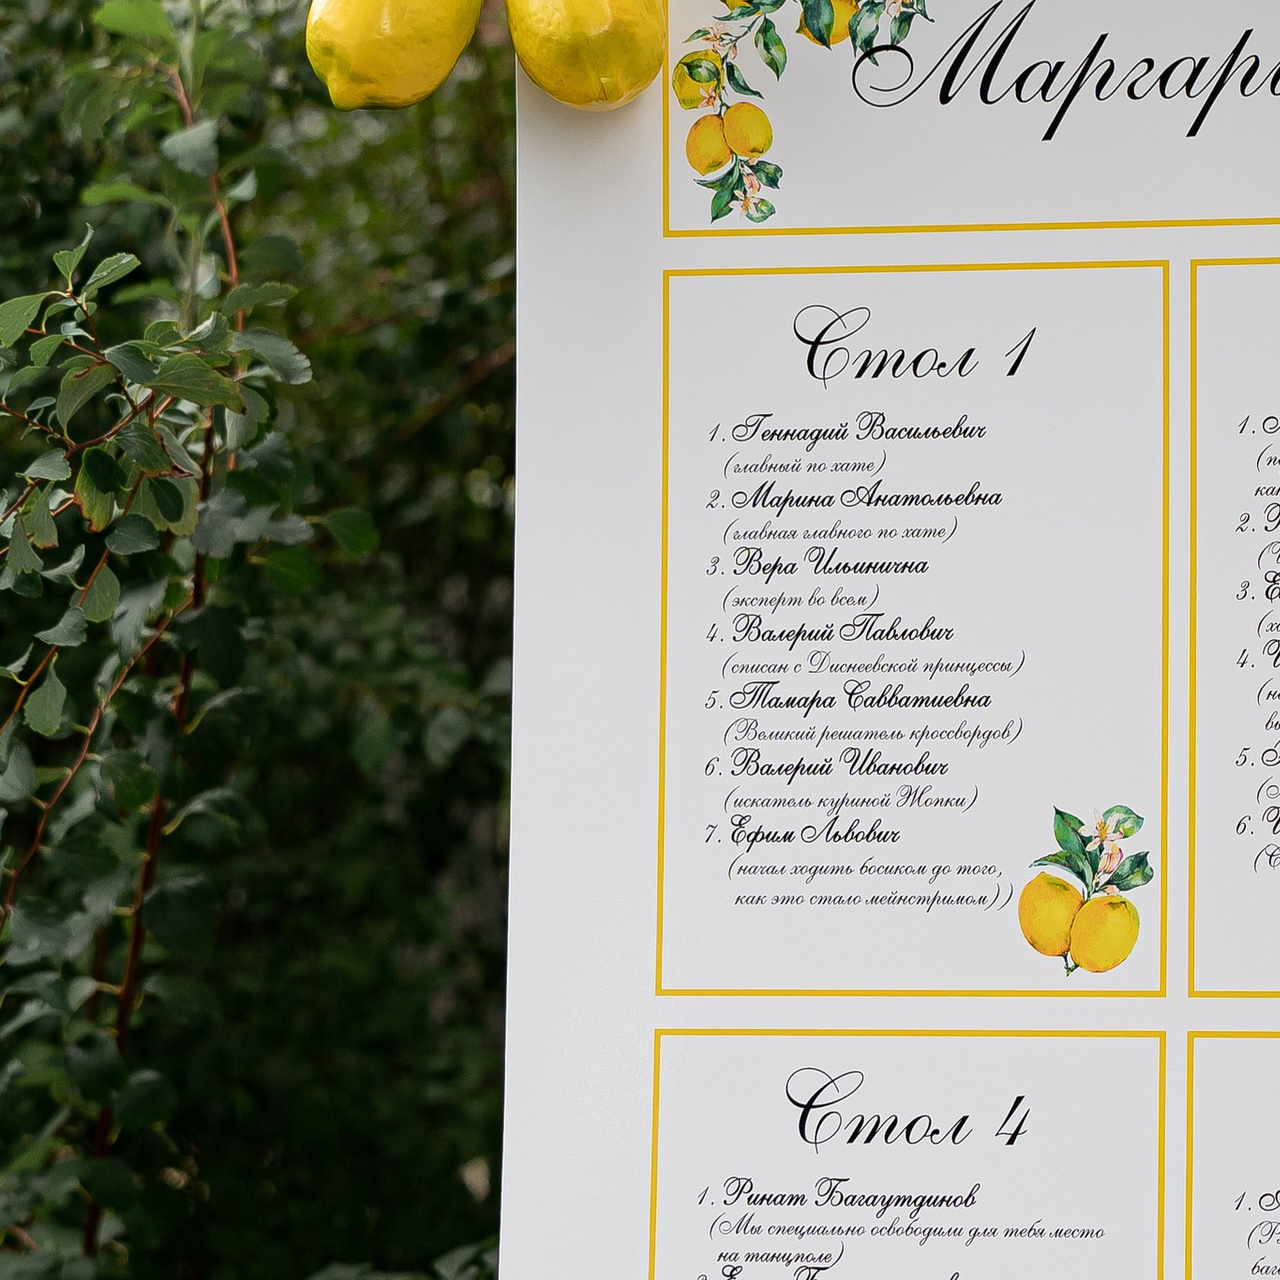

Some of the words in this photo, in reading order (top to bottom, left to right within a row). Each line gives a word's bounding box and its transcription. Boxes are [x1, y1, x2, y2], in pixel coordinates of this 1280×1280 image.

[793, 304, 980, 390] Стол
[1004, 326, 1037, 377] 1
[708, 422, 726, 442] 1.
[731, 412, 850, 453] Геннадий
[855, 410, 987, 441] Васильевич
[1238, 414, 1256, 435] 1.
[805, 462, 828, 473] по
[705, 489, 725, 509] 2.
[731, 480, 836, 518] Марина
[839, 478, 1004, 508] Анатольевна
[802, 520, 874, 540] главного
[876, 528, 899, 539] по
[1234, 512, 1256, 533] 2.
[705, 555, 725, 576] 3.
[732, 545, 799, 585] Вера
[803, 545, 930, 575] Ильинична
[705, 622, 724, 643] 4.
[732, 612, 835, 652] Валерий
[838, 612, 955, 642] Павлович
[793, 663, 803, 674] с
[806, 649, 919, 674] Диснеевской
[704, 756, 723, 777] 6.
[730, 746, 834, 786] Валерий
[838, 746, 949, 776] Иванович
[1235, 746, 1255, 767] 5.
[785, 1066, 974, 1155] Стол
[994, 1094, 1031, 1146] 4
[697, 1185, 715, 1206] 1.
[722, 1176, 809, 1207] Ринат
[814, 1176, 981, 1220] Багаутдинов
[1234, 1190, 1252, 1212] 1.
[767, 1225, 867, 1241] специально
[870, 1216, 965, 1247] освободили
[964, 1227, 999, 1247] для
[1002, 1218, 1047, 1239] тебя
[1048, 1227, 1105, 1239] место
[716, 1251, 741, 1263] на
